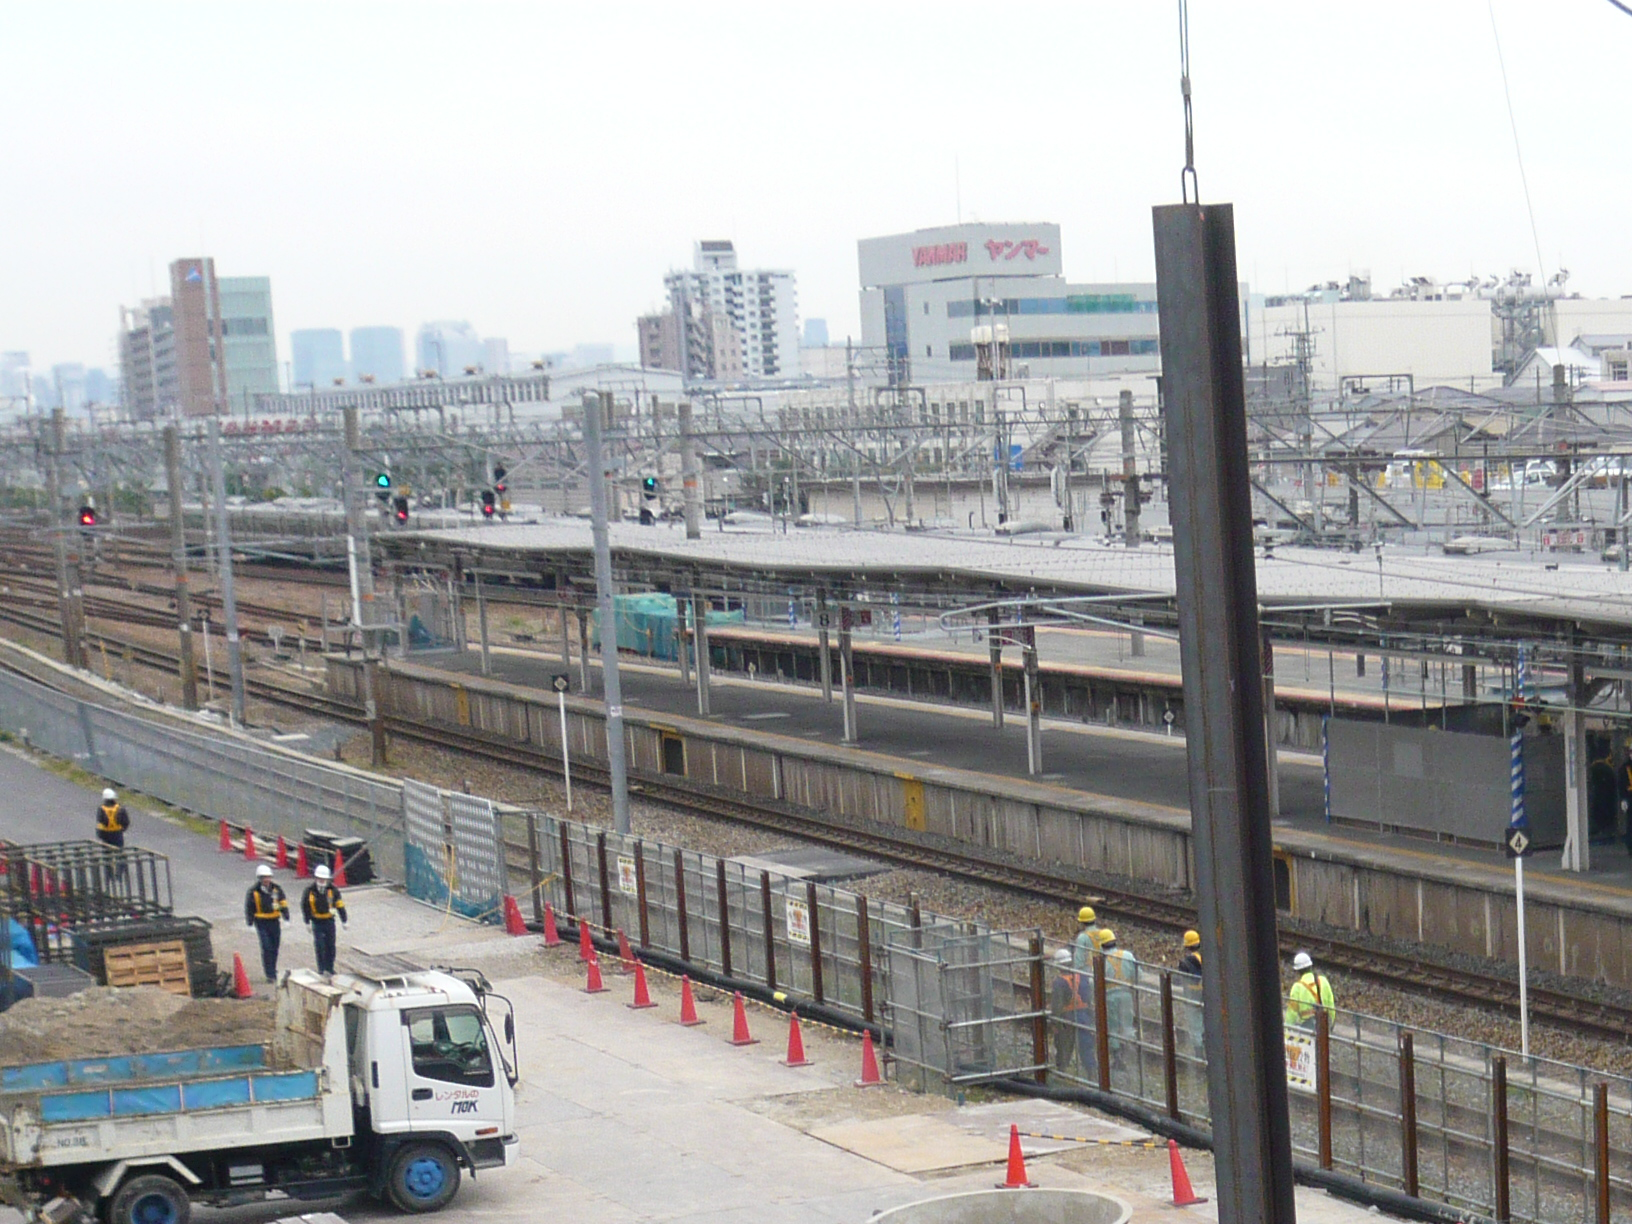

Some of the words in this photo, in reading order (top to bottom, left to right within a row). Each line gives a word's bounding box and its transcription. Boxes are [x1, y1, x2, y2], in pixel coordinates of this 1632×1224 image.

[912, 241, 968, 267] YANMAR
[984, 239, 1050, 260] ヤンマー
[435, 1089, 479, 1101] レンタルの
[451, 1100, 478, 1115] MOK
